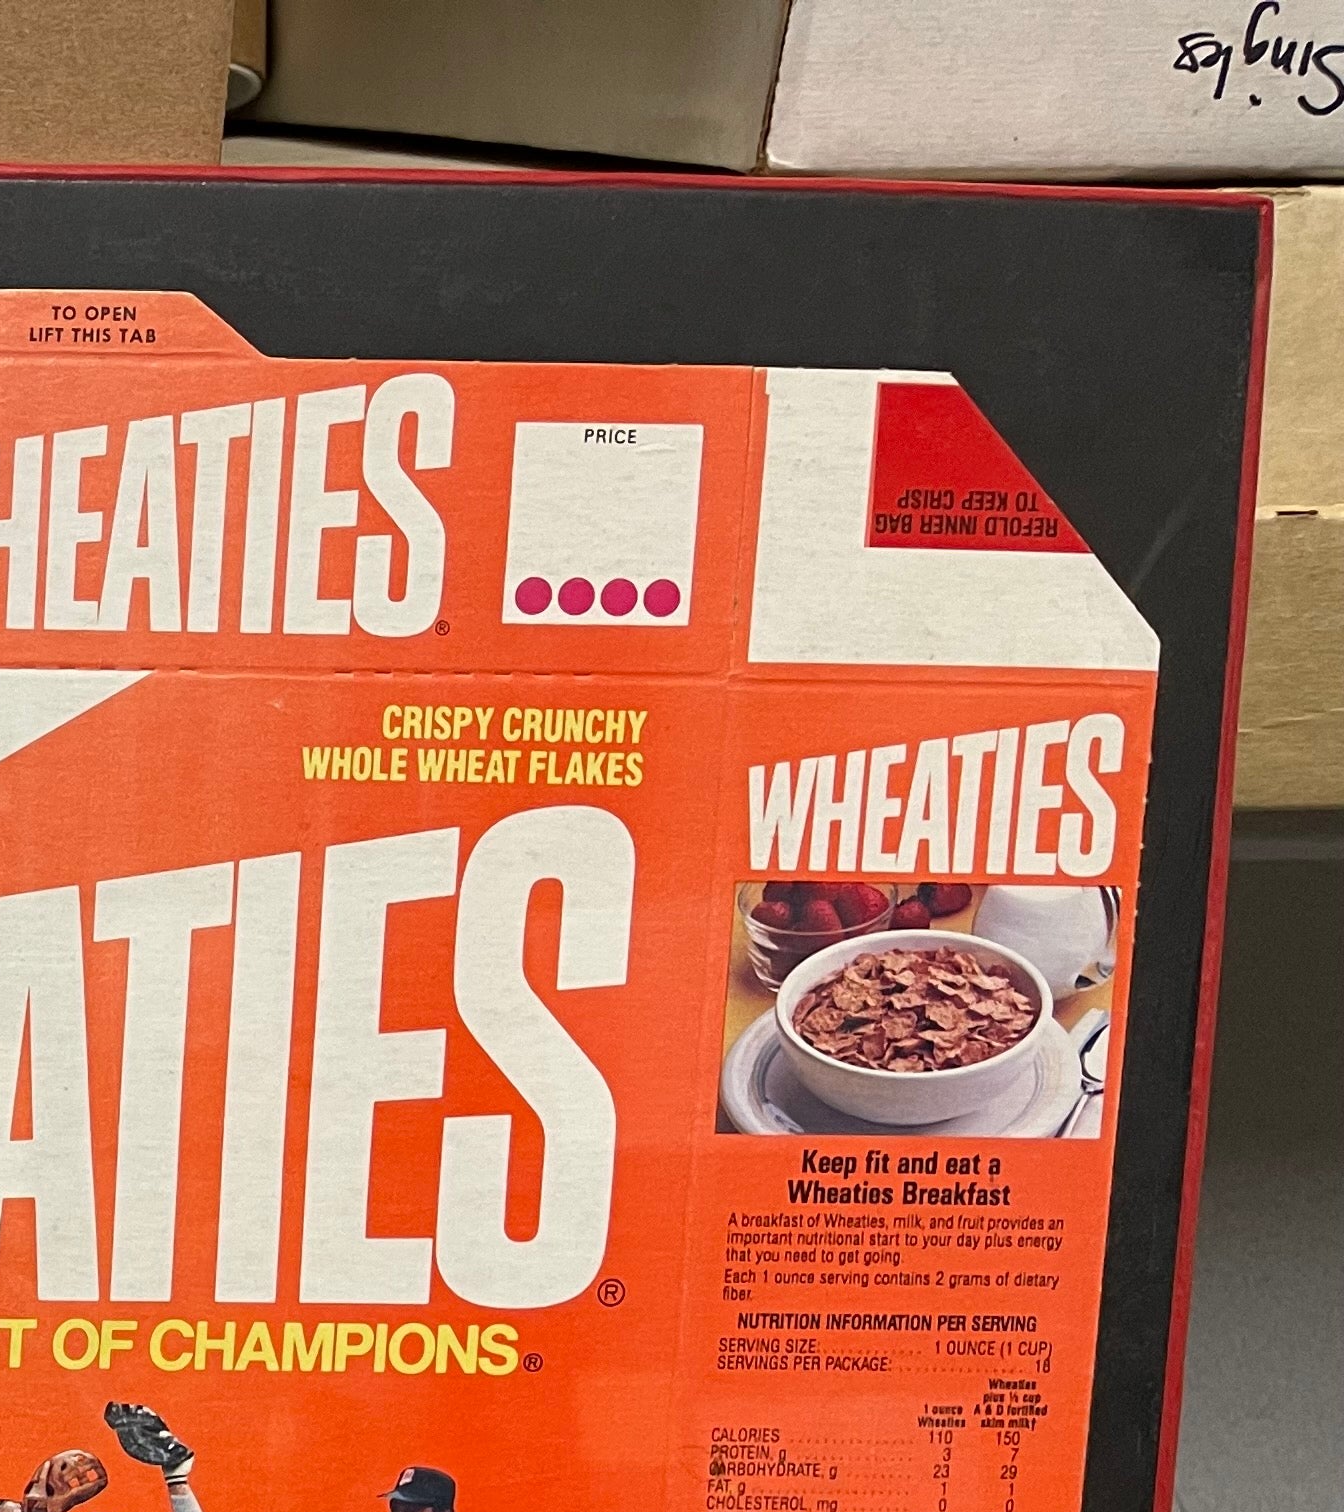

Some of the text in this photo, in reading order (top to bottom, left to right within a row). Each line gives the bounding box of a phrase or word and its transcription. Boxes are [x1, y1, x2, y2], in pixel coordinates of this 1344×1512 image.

[52, 306, 136, 321] TO OPEN
[29, 327, 155, 344] LIFT THIS TAB
[584, 428, 637, 444] PRICE
[382, 705, 647, 744] CRISPY CRUNCHY
[302, 747, 644, 786] WHOLE WHEAT FLAKES
[748, 713, 1125, 878] WHEATIES
[802, 1150, 1001, 1175] Keep fit and eat a
[787, 1180, 1011, 1205] Wheaties Breakfast
[737, 1312, 1037, 1333] NUTRITION INFORMATION PER SERVING
[52, 1317, 132, 1372] OF
[148, 1320, 518, 1377] CHAMPIONS
